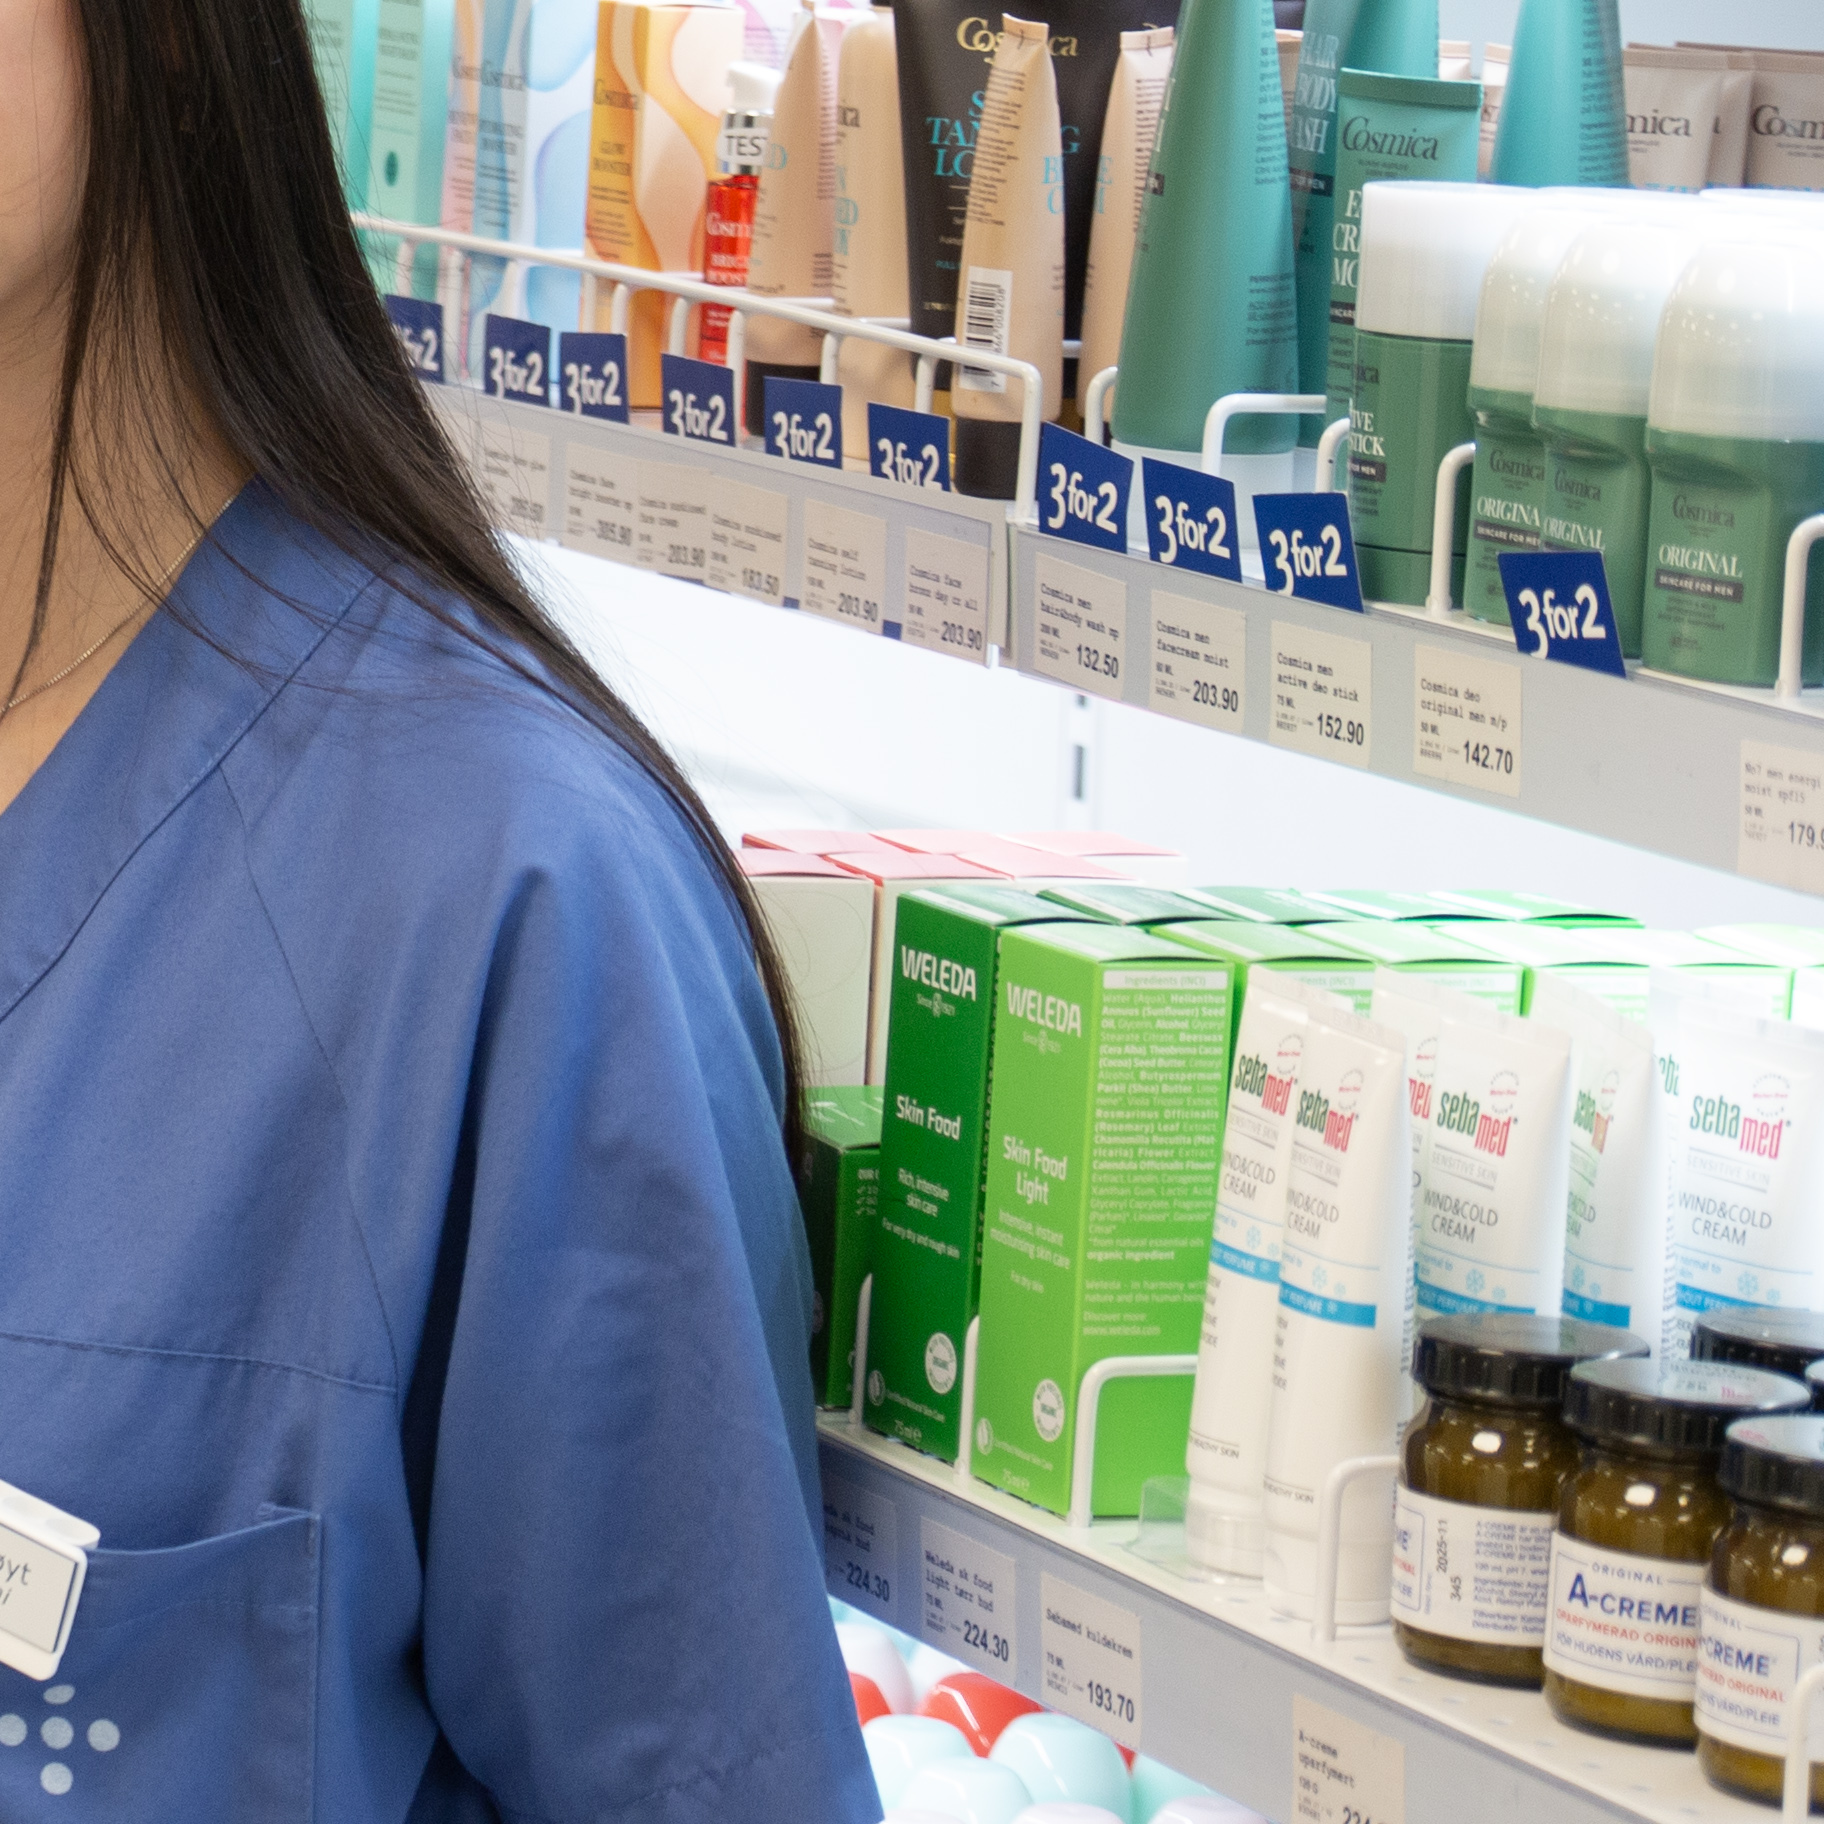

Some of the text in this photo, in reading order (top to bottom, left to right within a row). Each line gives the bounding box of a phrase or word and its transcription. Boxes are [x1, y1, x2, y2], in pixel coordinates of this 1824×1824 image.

[1341, 114, 1440, 162] Cosmica
[1489, 447, 1545, 481] Cosmica
[1553, 468, 1602, 502] Cosmica
[1477, 496, 1542, 528] ORIGINA
[1672, 492, 1735, 530] Cosmica
[1544, 516, 1606, 551] ORIGINAL
[1659, 543, 1743, 578] ORIGINAL
[1659, 576, 1734, 597] SKINCARE MEN
[838, 592, 878, 622] 203.90
[941, 620, 982, 651] 203.90
[1156, 620, 1190, 641] Cosmica
[1077, 645, 1119, 679] 132.50
[1277, 652, 1313, 673] Cosmica
[1192, 680, 1239, 713] 203.90
[1277, 672, 1359, 703] active stick
[1420, 677, 1481, 704] Cosmica deo
[1420, 698, 1464, 721] original
[1317, 713, 1364, 747] 152.90
[1463, 740, 1513, 775] 142.70
[902, 944, 977, 1003] WELEDA
[1007, 981, 1082, 1039] WELEDA
[1234, 1053, 1294, 1117] sebamed
[896, 1093, 962, 1142] Skin Food
[1297, 1088, 1355, 1154] sebamed
[1436, 1091, 1512, 1158] sebamed
[1689, 1094, 1784, 1160] sebamed
[1003, 1134, 1068, 1181] Skin Food
[1431, 1151, 1498, 1183] SENSITIVE SKIN
[1687, 1153, 1771, 1187] SENSITIVE SKIN
[1016, 1173, 1050, 1207] Light
[1223, 1172, 1257, 1202] CREAM
[1423, 1188, 1499, 1227] WIND&COLD
[1678, 1190, 1773, 1230] WIND&COLD
[1287, 1211, 1322, 1240] CREAM
[1431, 1213, 1476, 1245] CREAM
[1691, 1217, 1747, 1247] CREAM
[925, 1549, 954, 1575] Weleda
[1436, 1518, 1449, 1575] 2025-11
[846, 1562, 890, 1603] 224.30
[925, 1570, 950, 1594] light
[1450, 1575, 1462, 1603] 345
[1591, 1562, 1665, 1587] ORIGINAL
[1567, 1572, 1697, 1629] A-CREME
[963, 1619, 1009, 1664] 224.30
[1045, 1607, 1135, 1661] Sebamed kuldekrem
[1555, 1607, 1640, 1643] OPARFYMERAD
[1575, 1637, 1624, 1664] HUDENS
[1086, 1678, 1135, 1724] 193.70
[1298, 1728, 1338, 1759] A-creme
